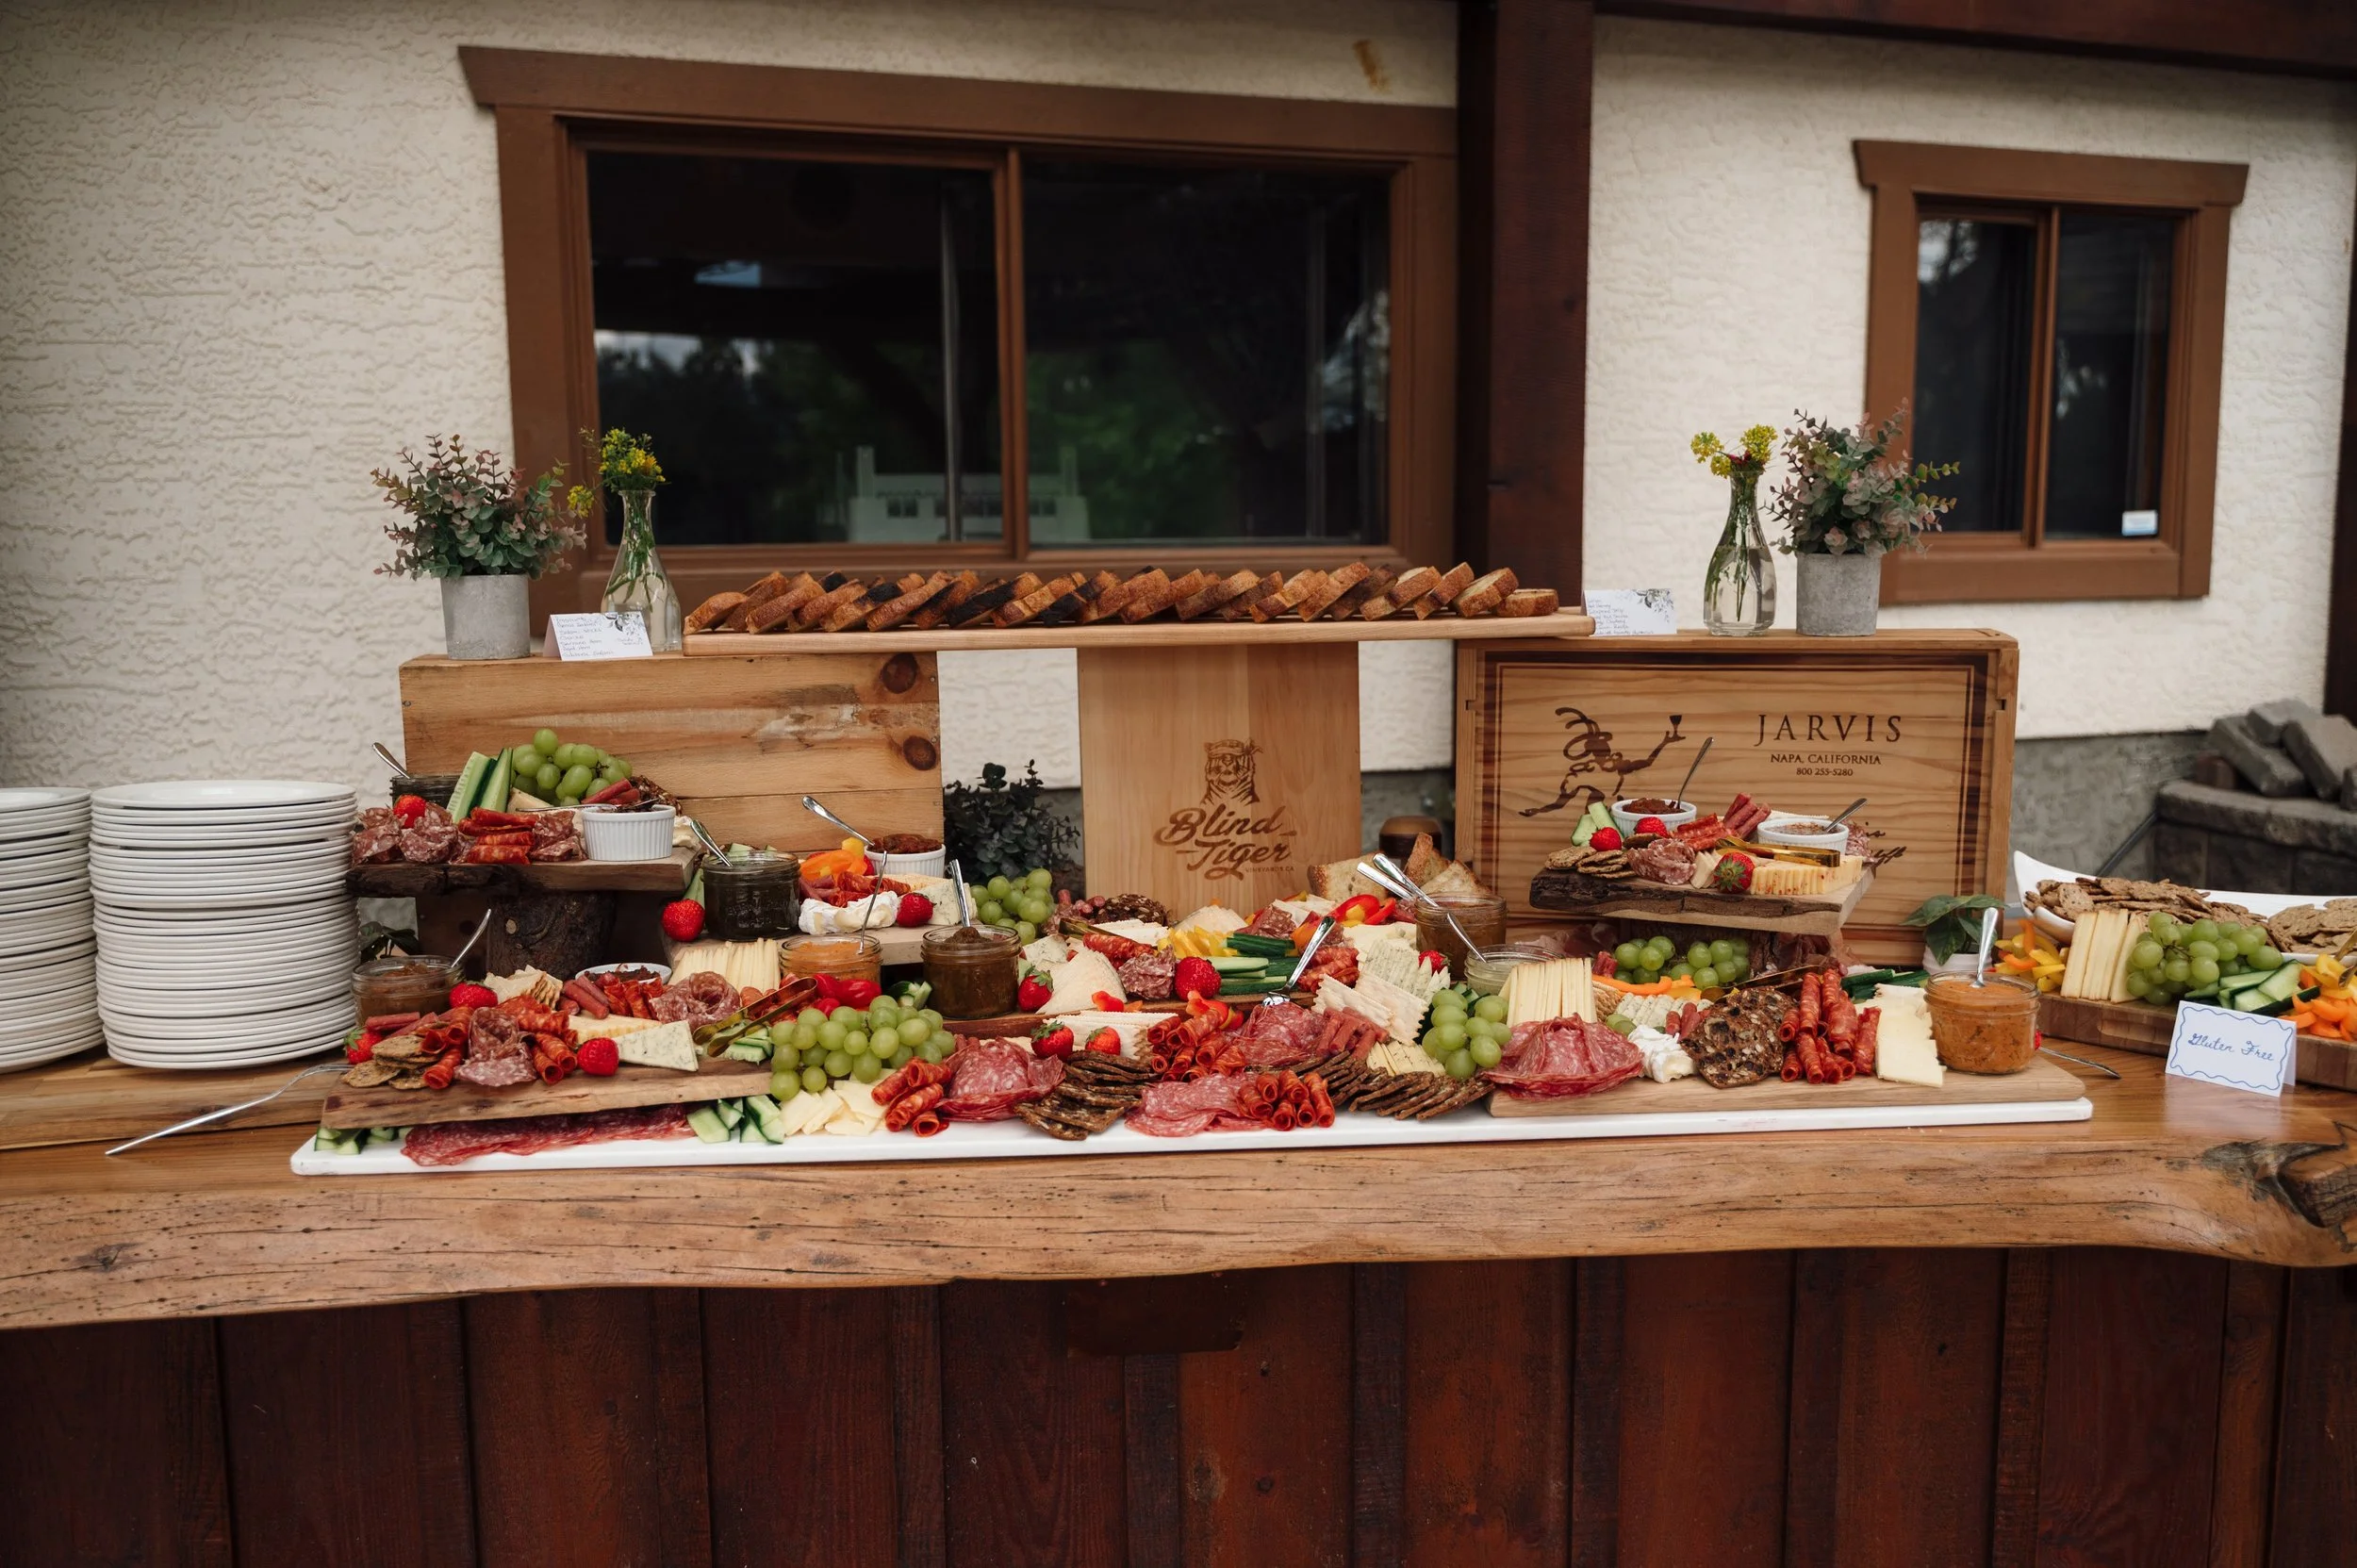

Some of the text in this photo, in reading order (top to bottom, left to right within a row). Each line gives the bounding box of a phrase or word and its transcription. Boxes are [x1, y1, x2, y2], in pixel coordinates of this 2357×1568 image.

[1754, 714, 1902, 747] JARVIS
[1796, 767, 1854, 777] 800 255-5280
[1807, 754, 1882, 766] CALIFORNIA
[1153, 803, 1287, 847] Blind
[1185, 838, 1292, 881] Tiger
[2187, 1032, 2275, 1062] Gluten Free
